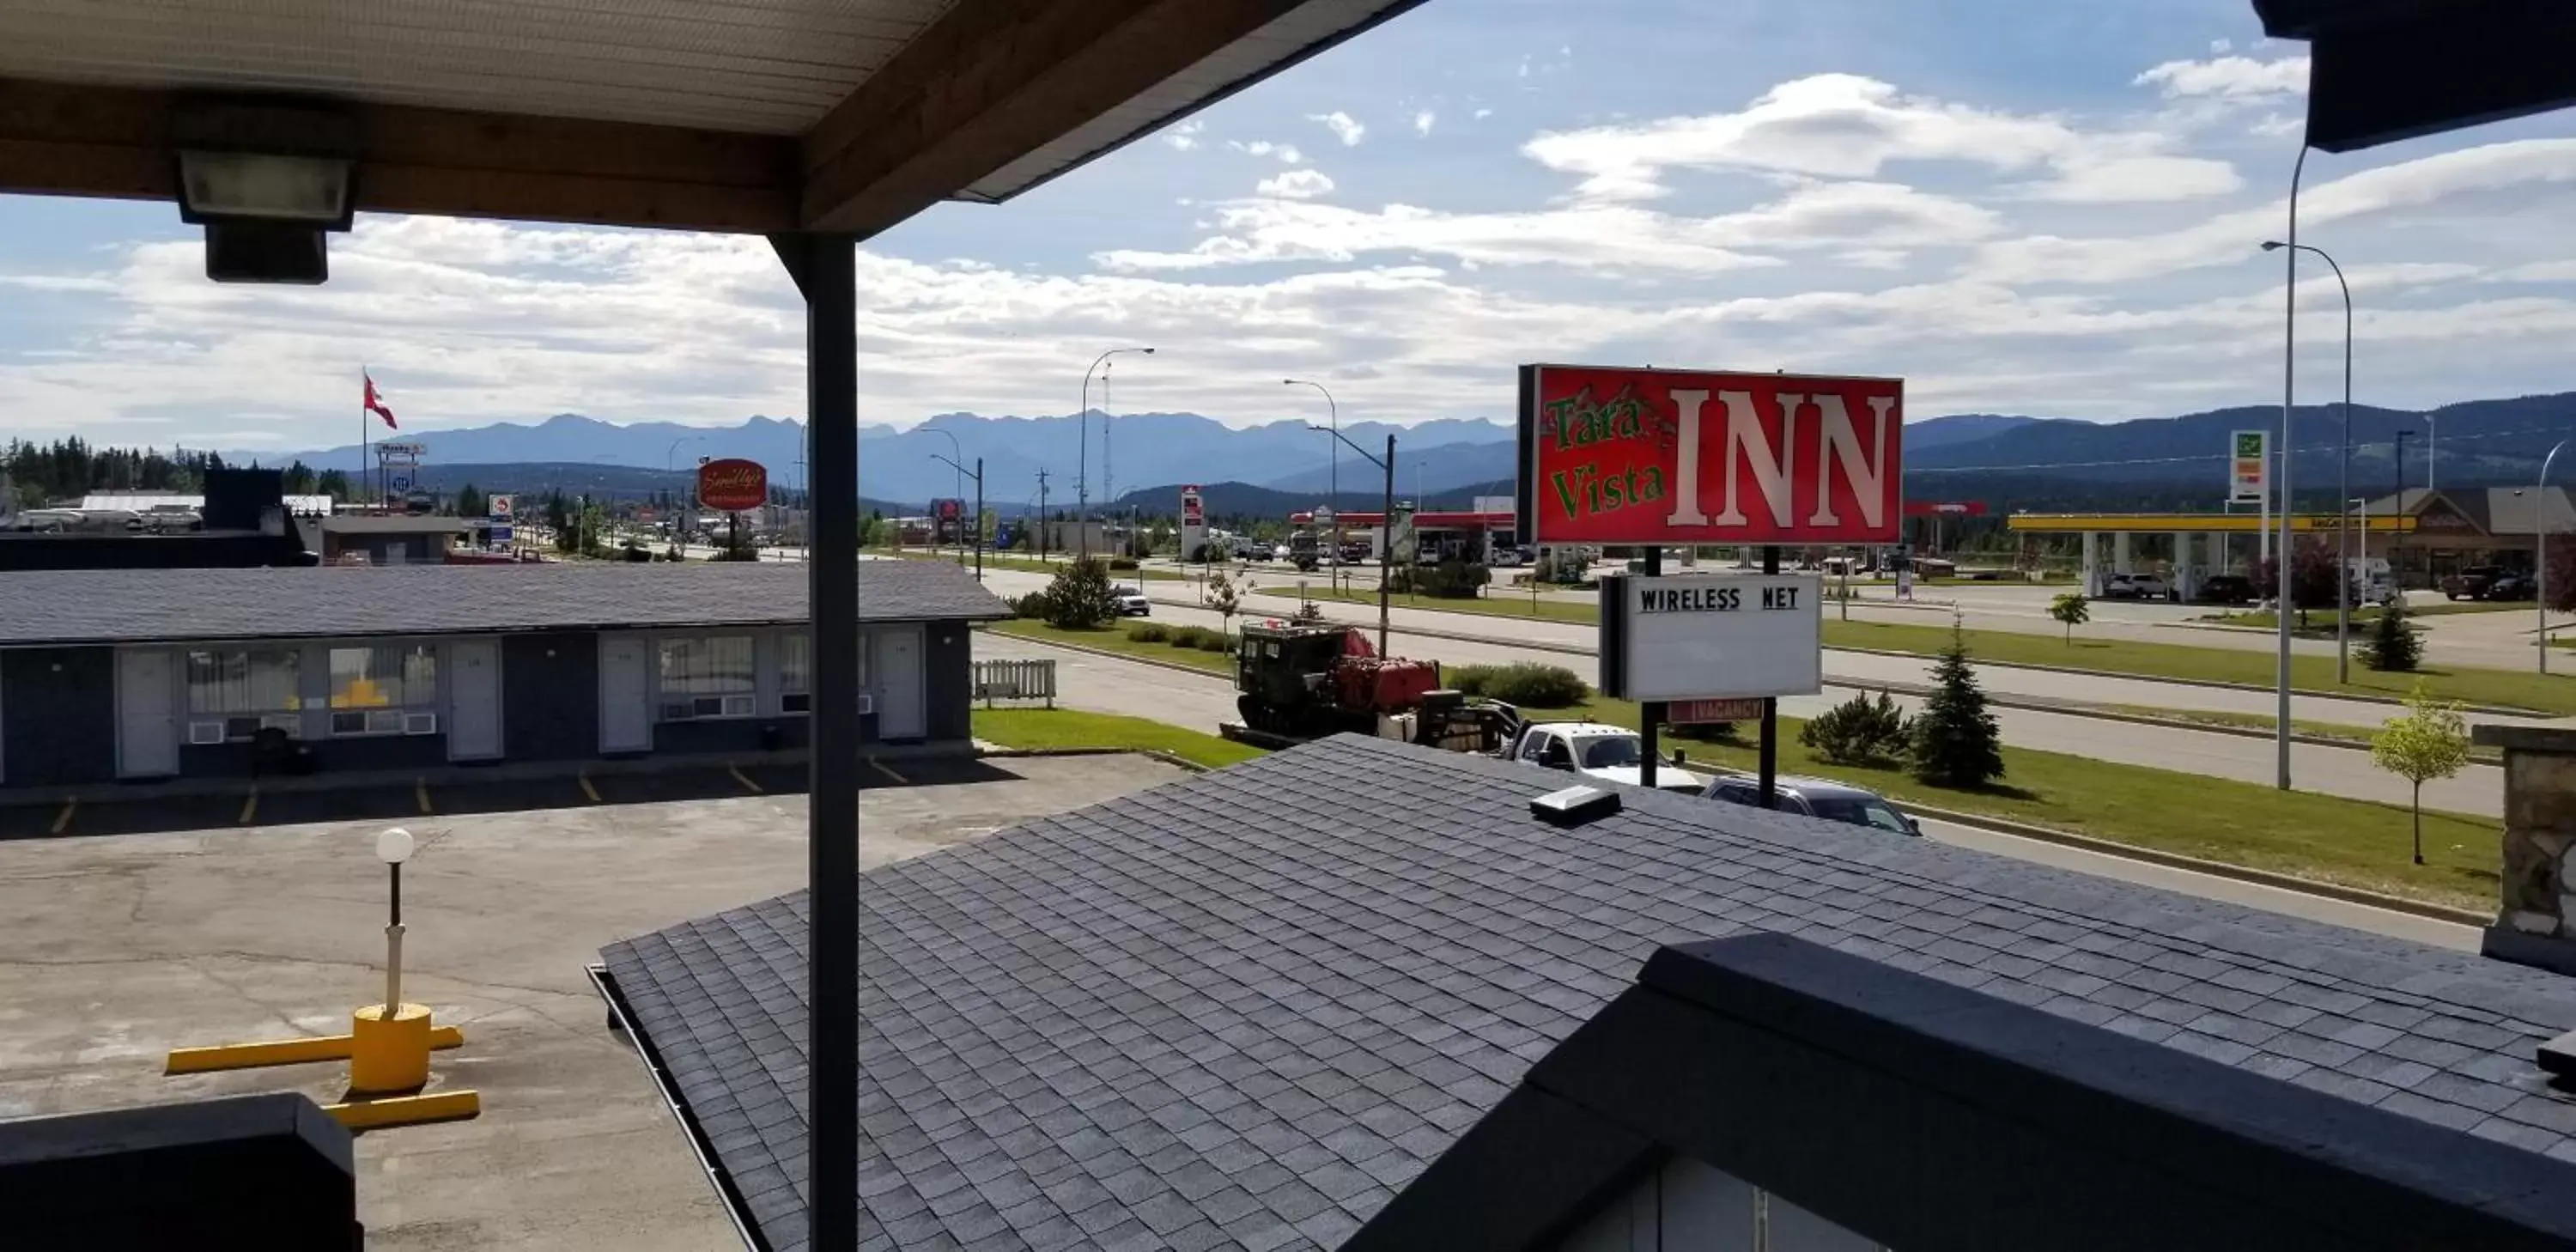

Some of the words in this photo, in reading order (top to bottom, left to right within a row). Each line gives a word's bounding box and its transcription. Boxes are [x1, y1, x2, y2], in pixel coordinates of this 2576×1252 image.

[1546, 396, 1644, 452] Tara
[1667, 389, 1895, 529] INN
[1552, 465, 1666, 521] Vista
[1640, 587, 1741, 611] WIRELESS
[1762, 586, 1800, 610] NET
[1697, 699, 1760, 719] VACANCY
